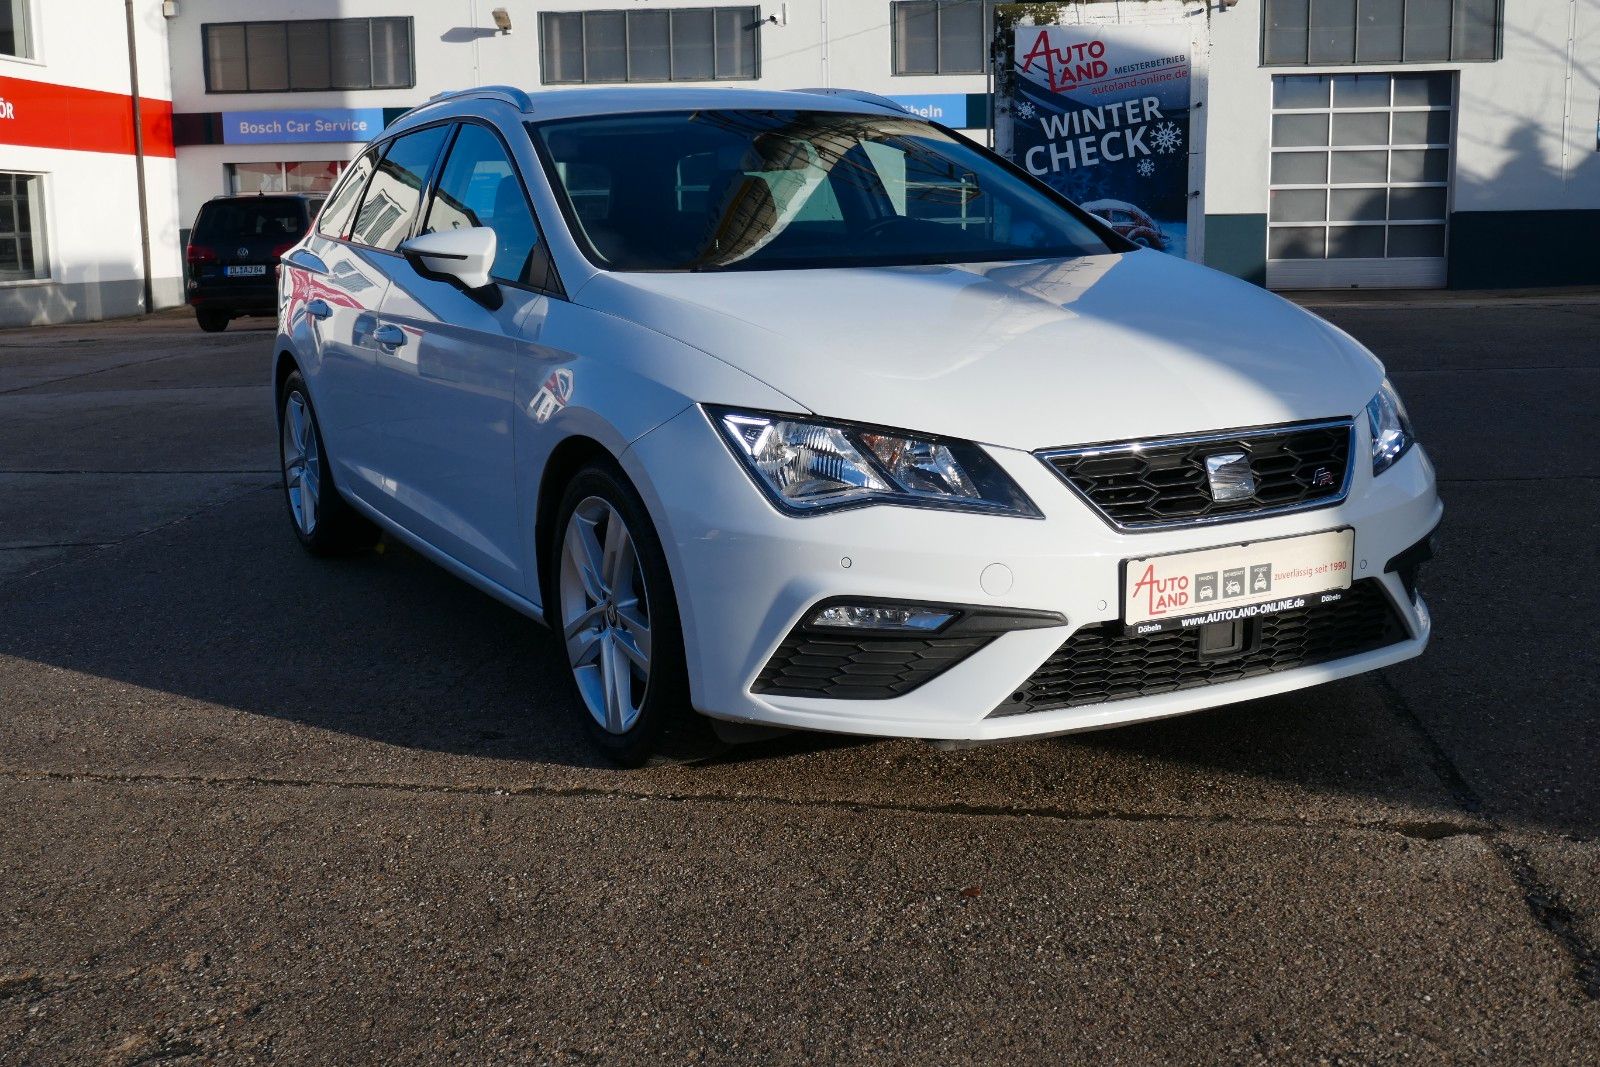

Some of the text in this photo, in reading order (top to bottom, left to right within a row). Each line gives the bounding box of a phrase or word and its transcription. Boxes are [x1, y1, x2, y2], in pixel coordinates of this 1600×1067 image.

[1023, 30, 1105, 73] AUTO
[1114, 54, 1186, 75] MEISTERBETRIEB
[1047, 60, 1109, 93] LAND
[1091, 69, 1188, 95] autoland-online.de
[240, 119, 368, 134] Bosch Car Service
[1040, 96, 1164, 140] WINTER
[1025, 125, 1151, 176] CHECK
[1133, 564, 1189, 598] AUTO
[1274, 568, 1313, 581] zuverlässig
[1315, 564, 1328, 574] seit
[1329, 560, 1347, 572] 1990
[1149, 591, 1189, 615] LAND
[1181, 598, 1305, 627] www.AUTOLAND-ONLINE.de
[1138, 623, 1162, 634] Döbeln
